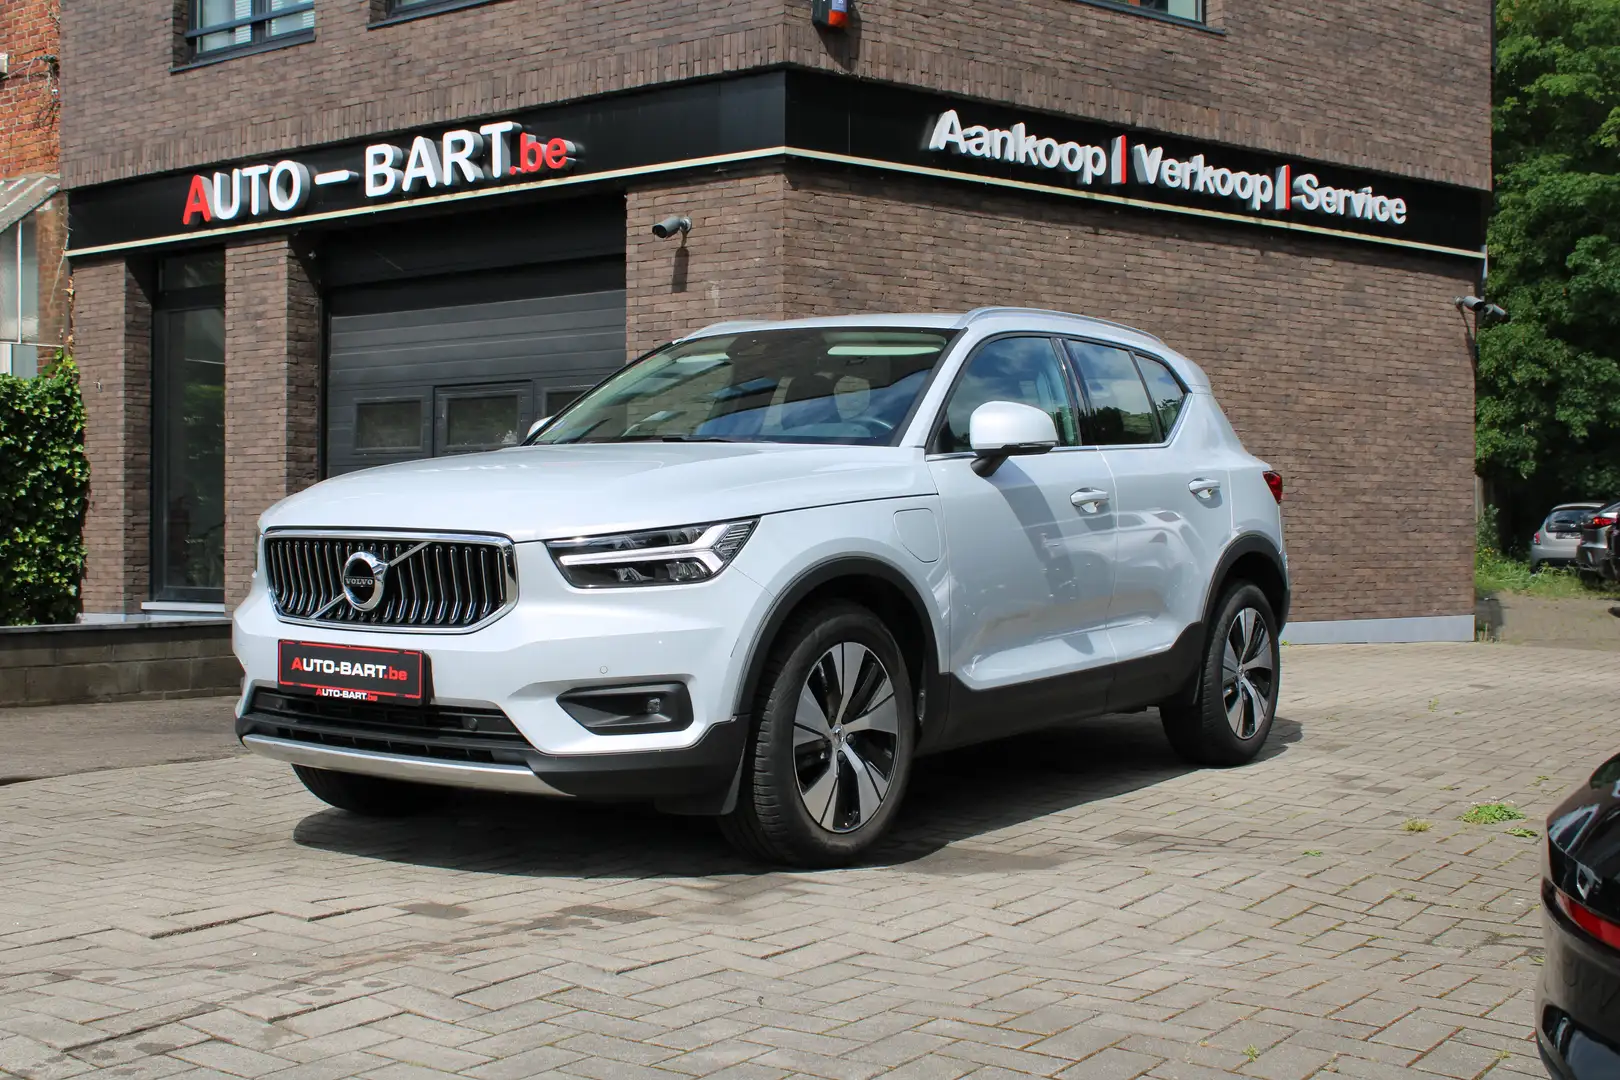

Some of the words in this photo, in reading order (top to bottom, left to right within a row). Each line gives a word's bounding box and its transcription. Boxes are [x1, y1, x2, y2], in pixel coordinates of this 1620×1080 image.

[928, 109, 1107, 185] Aankoop
[1133, 143, 1274, 210] Verkoop
[1292, 172, 1408, 225] Service
[345, 578, 373, 586] VOLVO
[290, 656, 408, 681] AUTO-BART.be
[315, 688, 378, 702] AUTO-BART.be
